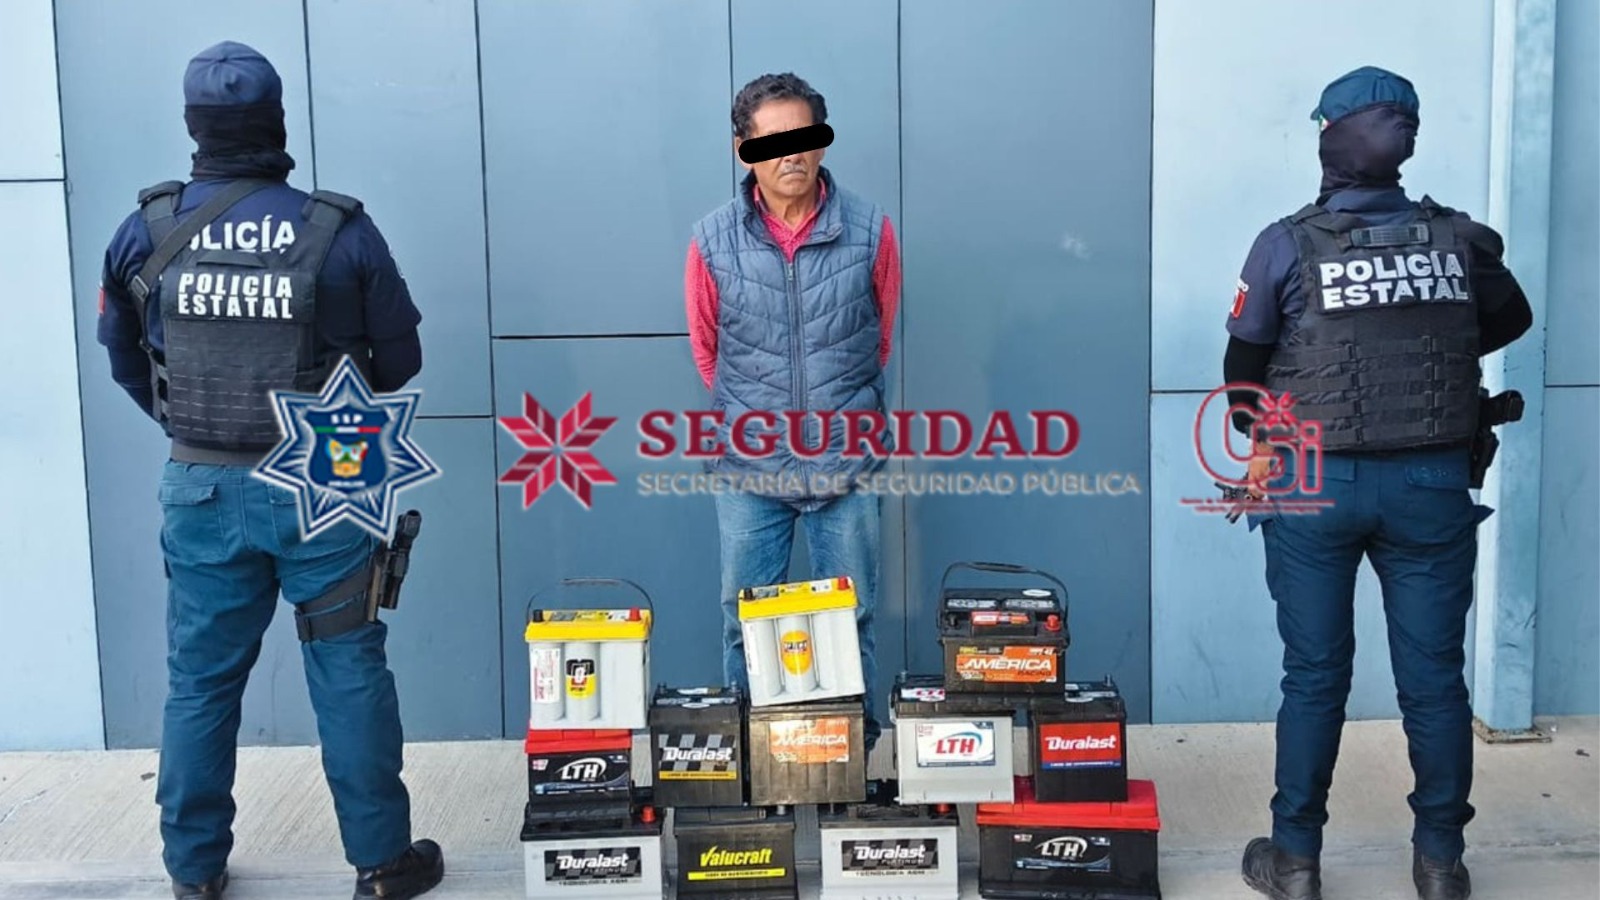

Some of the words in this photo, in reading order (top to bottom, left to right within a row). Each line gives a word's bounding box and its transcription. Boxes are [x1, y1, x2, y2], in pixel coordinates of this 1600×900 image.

[1319, 251, 1464, 285] POLICÍA
[178, 273, 293, 298] POLICÍA
[1322, 278, 1468, 310] ESTATAL
[178, 295, 293, 319] ESTATAL
[936, 738, 976, 754] LTH
[1045, 735, 1117, 751] Duralast
[663, 747, 733, 761] Duralast
[561, 763, 599, 780] LTH
[700, 845, 772, 867] Valucraft
[854, 844, 926, 860] Duralast
[1041, 842, 1079, 857] LTH
[556, 853, 629, 870] Duralast
